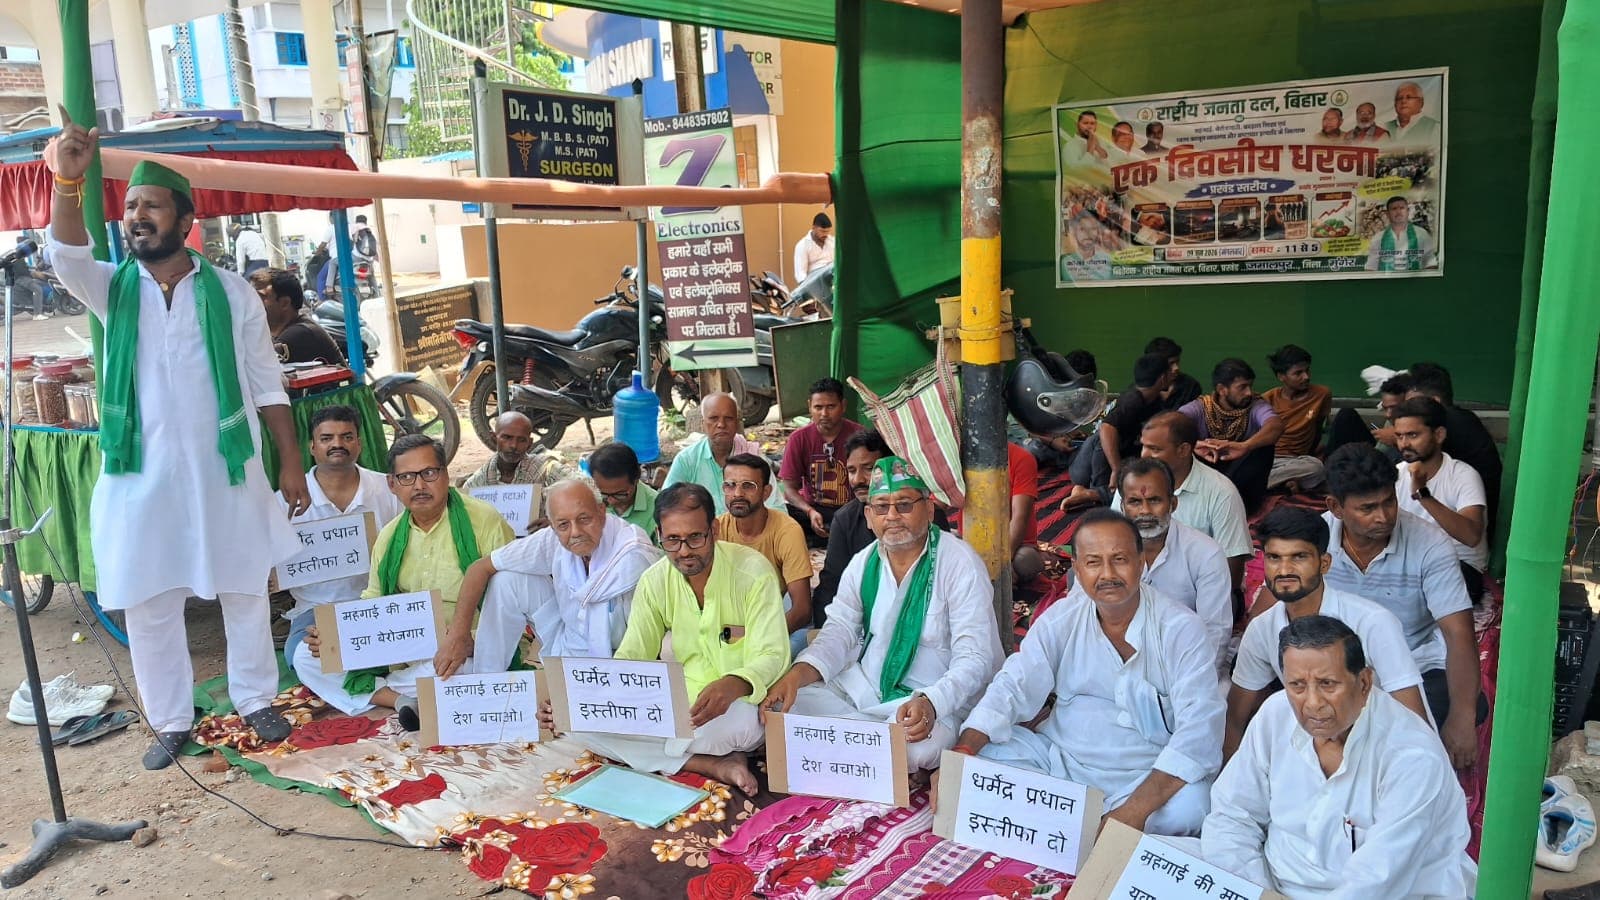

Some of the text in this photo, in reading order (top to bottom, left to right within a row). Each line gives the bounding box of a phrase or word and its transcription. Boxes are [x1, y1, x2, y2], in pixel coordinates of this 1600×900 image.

[508, 98, 613, 132] Dr. J. D. Singh
[1156, 90, 1329, 121] राष्ट्रीय जनता दल, बिहार
[672, 110, 729, 130] 8448357802
[554, 132, 563, 142] B.
[565, 133, 574, 143] B.
[576, 134, 585, 144] S.
[587, 134, 609, 147] (PAT)
[576, 147, 598, 159] (PAT)
[540, 160, 613, 177] SURGEON
[1111, 138, 1379, 193] एक दिवसीय धरना
[1209, 180, 1268, 195] प्रखंड स्तरीय
[657, 216, 740, 238] Electronics
[667, 241, 691, 259] हमारे
[712, 237, 733, 254] सभी
[1251, 245, 1274, 254] समय
[1285, 245, 1297, 253] 11
[1300, 242, 1308, 252] से
[1311, 244, 1318, 252] 5
[662, 265, 688, 281] प्रकार
[689, 262, 700, 277] के
[669, 283, 683, 299] एवं
[667, 305, 697, 318] सामान
[699, 300, 724, 316] उचित
[681, 325, 694, 336] पर
[696, 321, 726, 336] मिलता
[502, 490, 527, 502] हटाओ
[322, 525, 359, 541] प्रधान
[286, 549, 360, 577] इस्तीफा दो
[342, 600, 426, 621] महंगाई की मार
[351, 635, 371, 650] युवा
[444, 679, 528, 697] महंगाई हटाओ
[619, 673, 661, 688] प्रधान
[453, 708, 523, 726] देश बचाओ।
[579, 701, 663, 723] इस्तीफा दो
[794, 723, 882, 746] महंगाई हटाओ
[802, 755, 876, 780] देश बचाओ।
[1026, 787, 1076, 814] प्रधान
[969, 812, 1068, 853] इस्तीफा दो
[1140, 850, 1249, 900] महंगाई की मा
